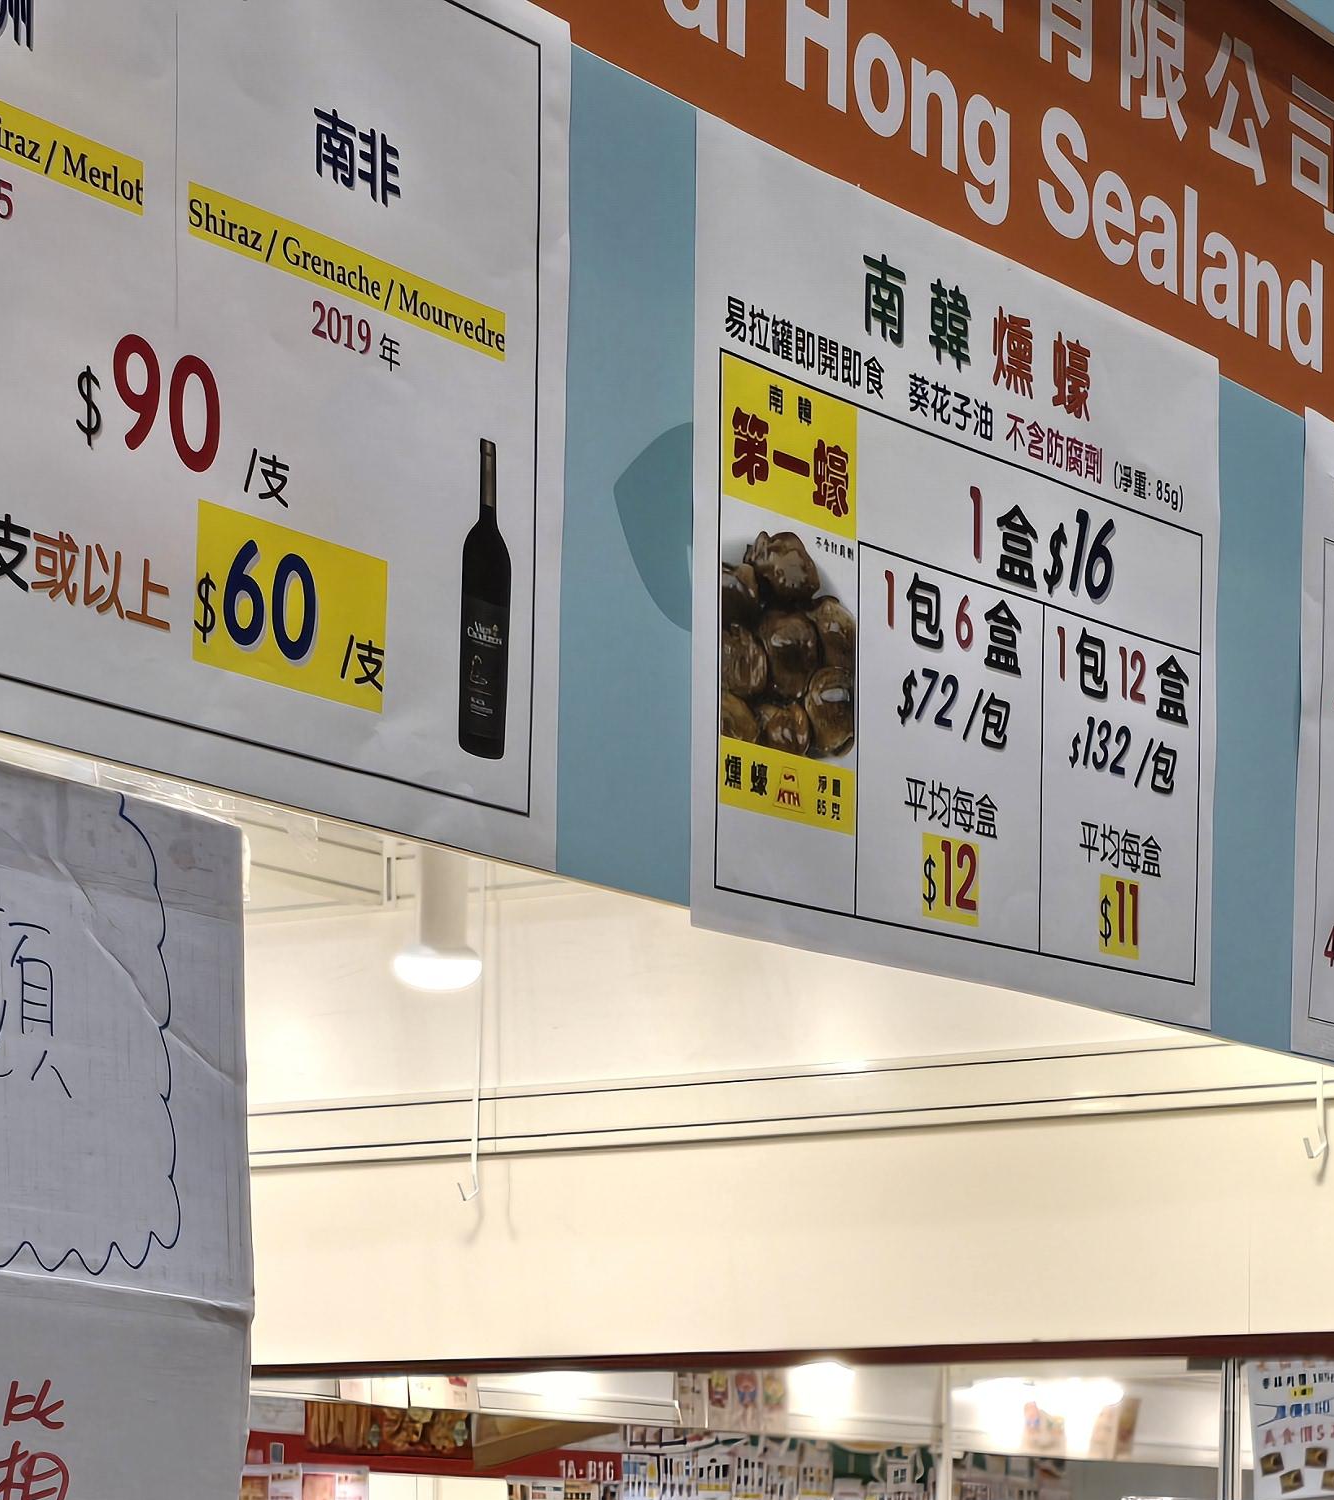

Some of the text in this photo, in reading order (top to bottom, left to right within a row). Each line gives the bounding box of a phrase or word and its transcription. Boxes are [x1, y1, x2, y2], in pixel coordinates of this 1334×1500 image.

[62, 144, 145, 205] Merlot
[312, 107, 401, 207] 南非
[784, 0, 1012, 227] Hong
[1037, 105, 1325, 374] Sealand
[187, 196, 506, 354] Shiraz Grenache Mourvedre
[310, 300, 372, 357] 2019
[723, 296, 886, 400] 易拉罐即開即食
[907, 372, 995, 443] 葵花子油
[1005, 411, 1103, 486] 不含防腐劑
[731, 406, 849, 518] 第一蠔
[192, 538, 317, 665] $60
[904, 777, 999, 841] 平均每盒
[1080, 820, 1163, 879] 平均每盒
[924, 840, 979, 912] $12
[1100, 883, 1140, 949] $11
